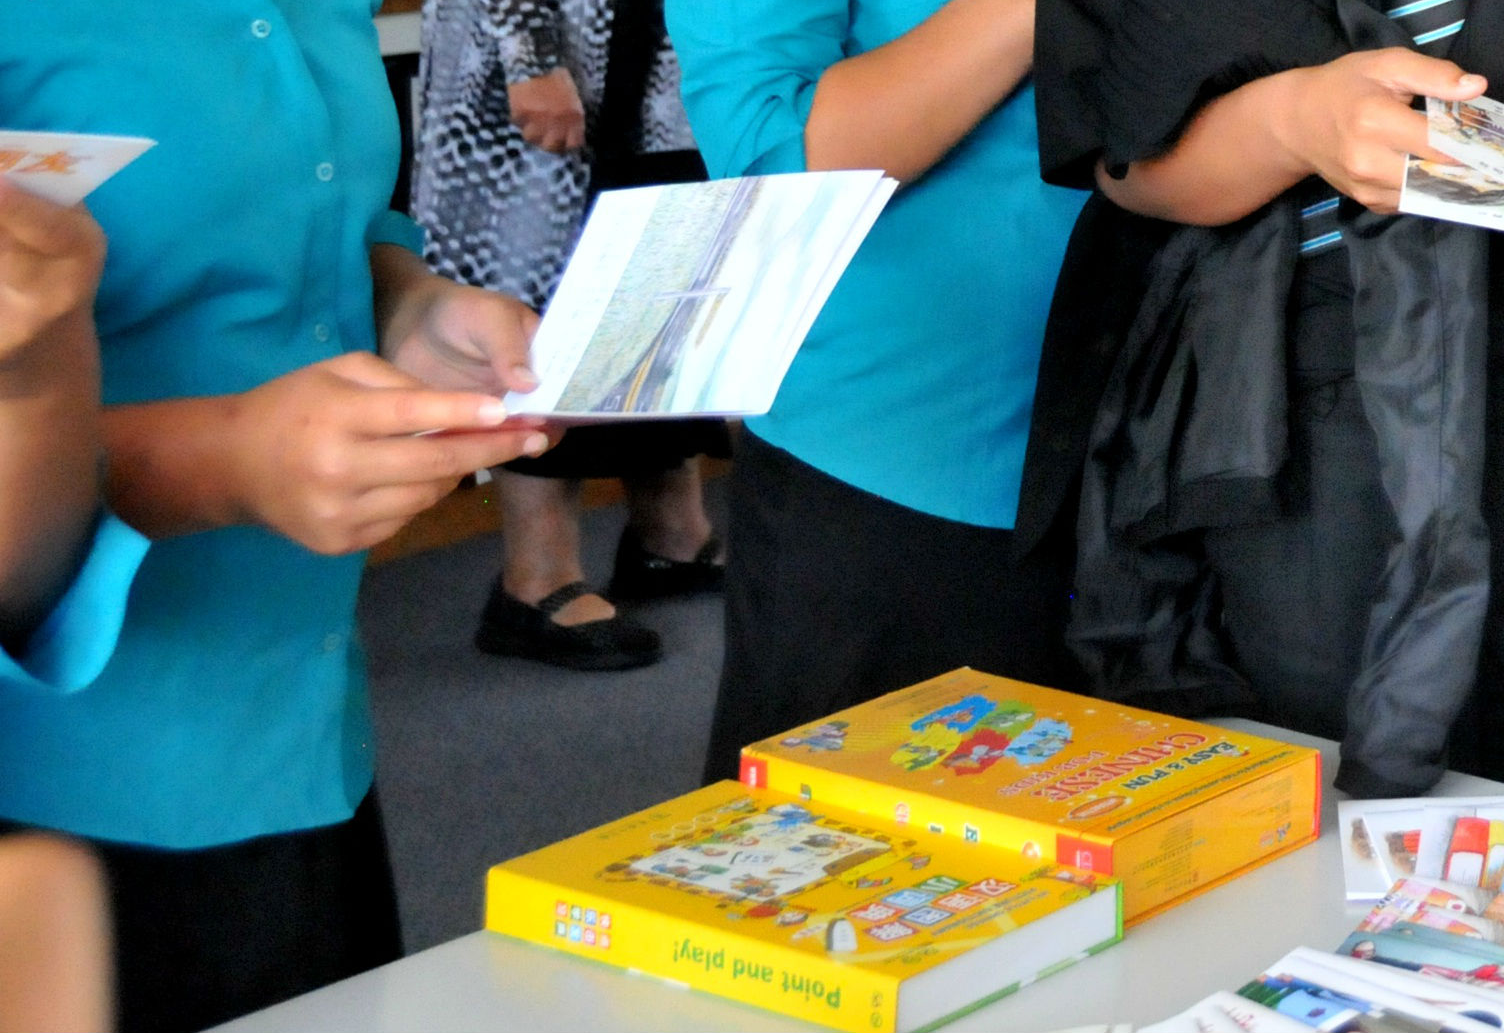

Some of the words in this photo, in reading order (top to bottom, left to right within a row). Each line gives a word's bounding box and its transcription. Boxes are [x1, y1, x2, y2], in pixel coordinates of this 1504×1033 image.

[1031, 731, 1208, 802] CHINESE
[1183, 740, 1237, 766] EASY
[1121, 770, 1171, 791] FUN
[673, 938, 725, 972] play!
[732, 958, 774, 983] and
[782, 970, 842, 1009] Point
